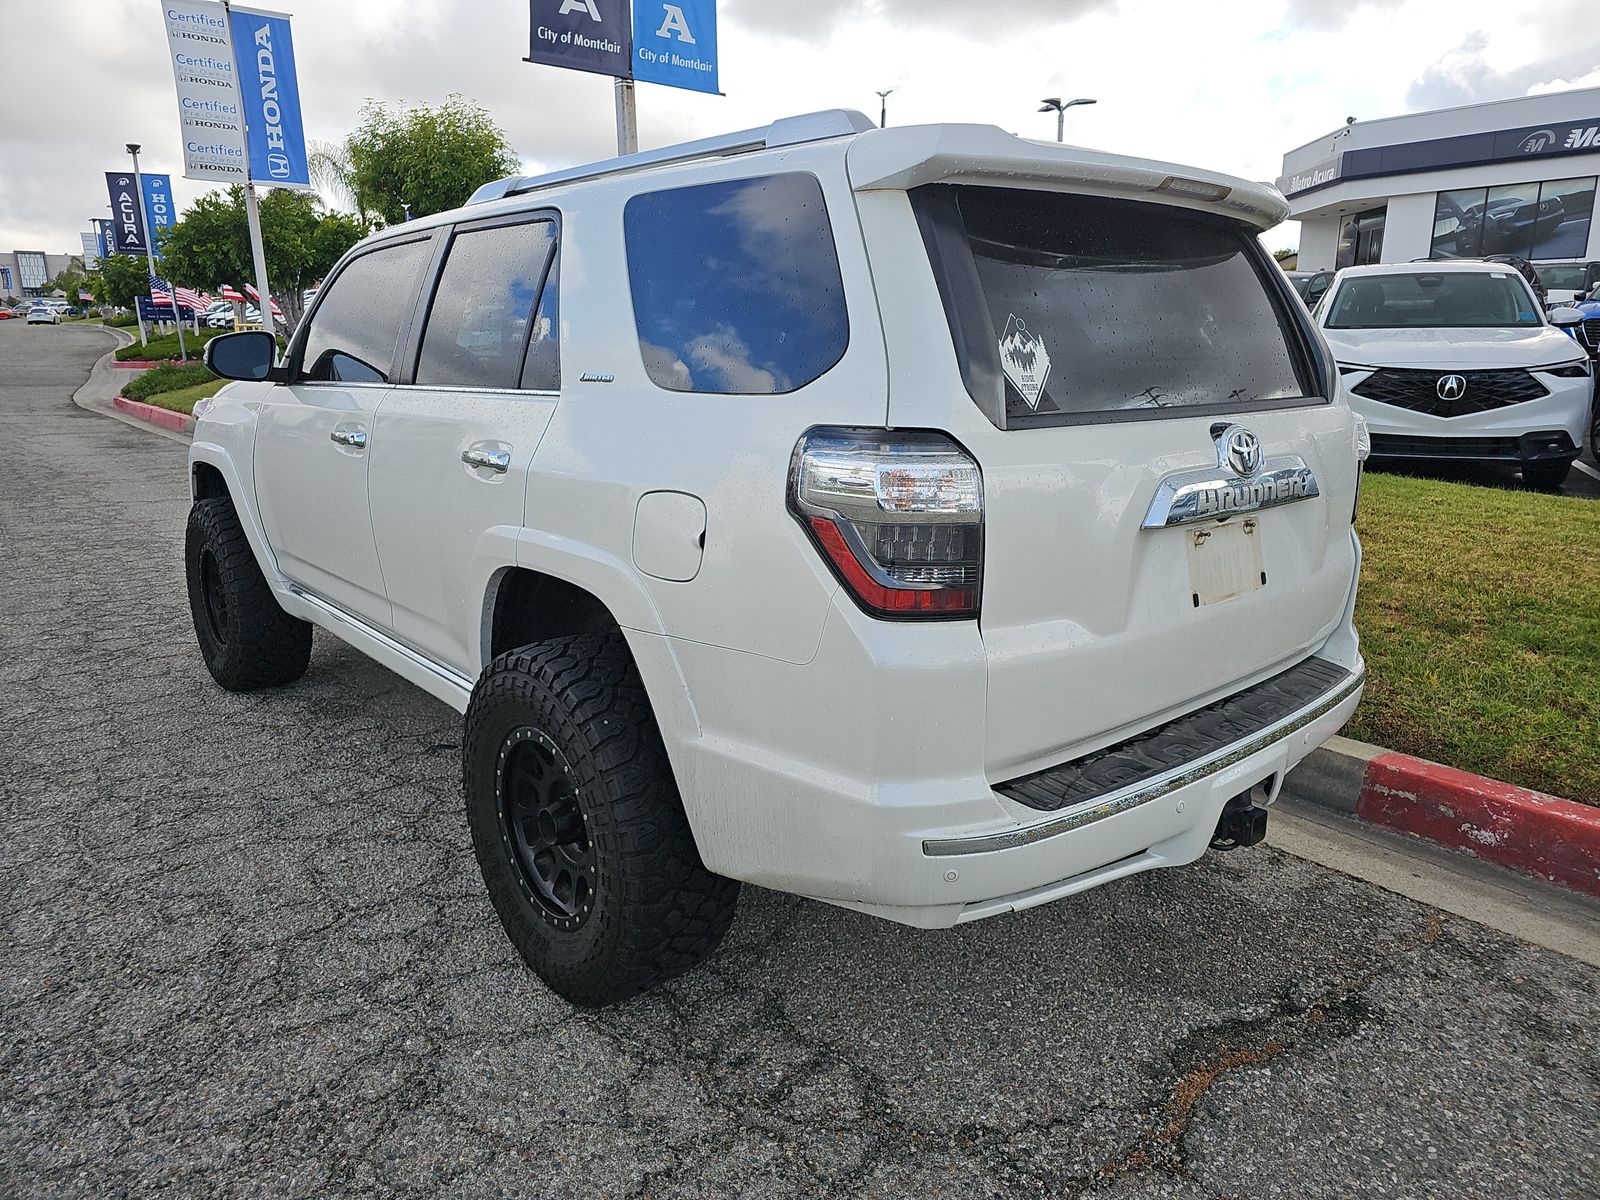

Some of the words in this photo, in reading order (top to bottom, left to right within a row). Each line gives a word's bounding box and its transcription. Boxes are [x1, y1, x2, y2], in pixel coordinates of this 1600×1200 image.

[168, 9, 225, 28] Certified
[182, 32, 228, 45] HONDA
[538, 26, 558, 44] City
[561, 31, 572, 44] of
[574, 34, 621, 54] Montclair
[175, 53, 231, 72] Certified
[639, 48, 658, 65] City
[659, 52, 670, 64] of
[671, 55, 714, 73] Montclair
[189, 76, 233, 89] HONDA
[255, 23, 285, 151] HONDA
[182, 97, 237, 114] Certified
[195, 119, 239, 131] HONDA
[187, 141, 242, 157] Certified
[199, 163, 243, 174] HONDA
[1290, 175, 1311, 192] Metro
[1311, 167, 1334, 186] Acura
[119, 191, 140, 245] ACURA
[151, 193, 168, 228] HON
